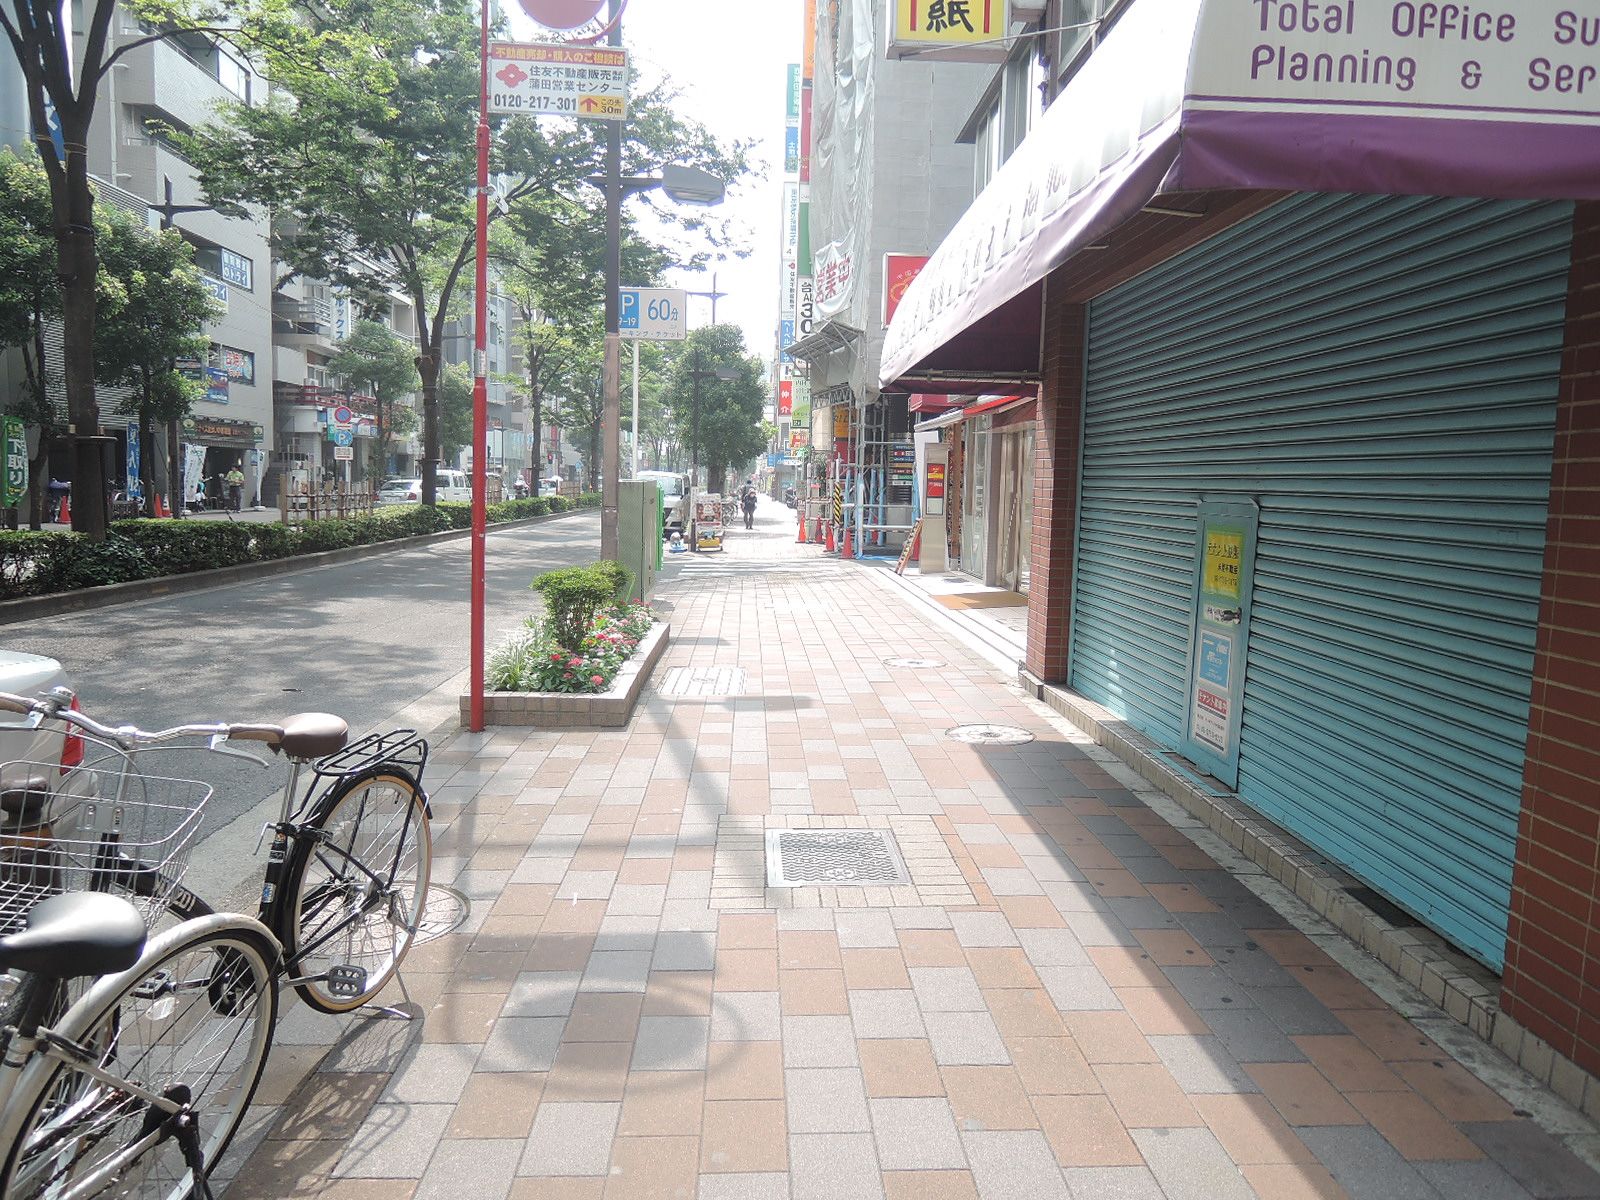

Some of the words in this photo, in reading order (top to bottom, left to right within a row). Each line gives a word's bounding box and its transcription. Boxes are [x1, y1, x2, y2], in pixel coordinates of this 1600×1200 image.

[1253, 0, 1355, 34] Total
[1391, 1, 1516, 42] Office
[1250, 43, 1417, 92] Planning
[1460, 60, 1483, 90] &
[1528, 57, 1598, 94] Ser
[529, 78, 622, 94] 蒲田営業センター
[494, 93, 577, 112] 0120-217-301
[601, 105, 622, 115] 30m
[816, 253, 850, 304] 営業中
[622, 294, 634, 315] P
[648, 299, 679, 321] 60分
[7, 438, 24, 485] 下取り
